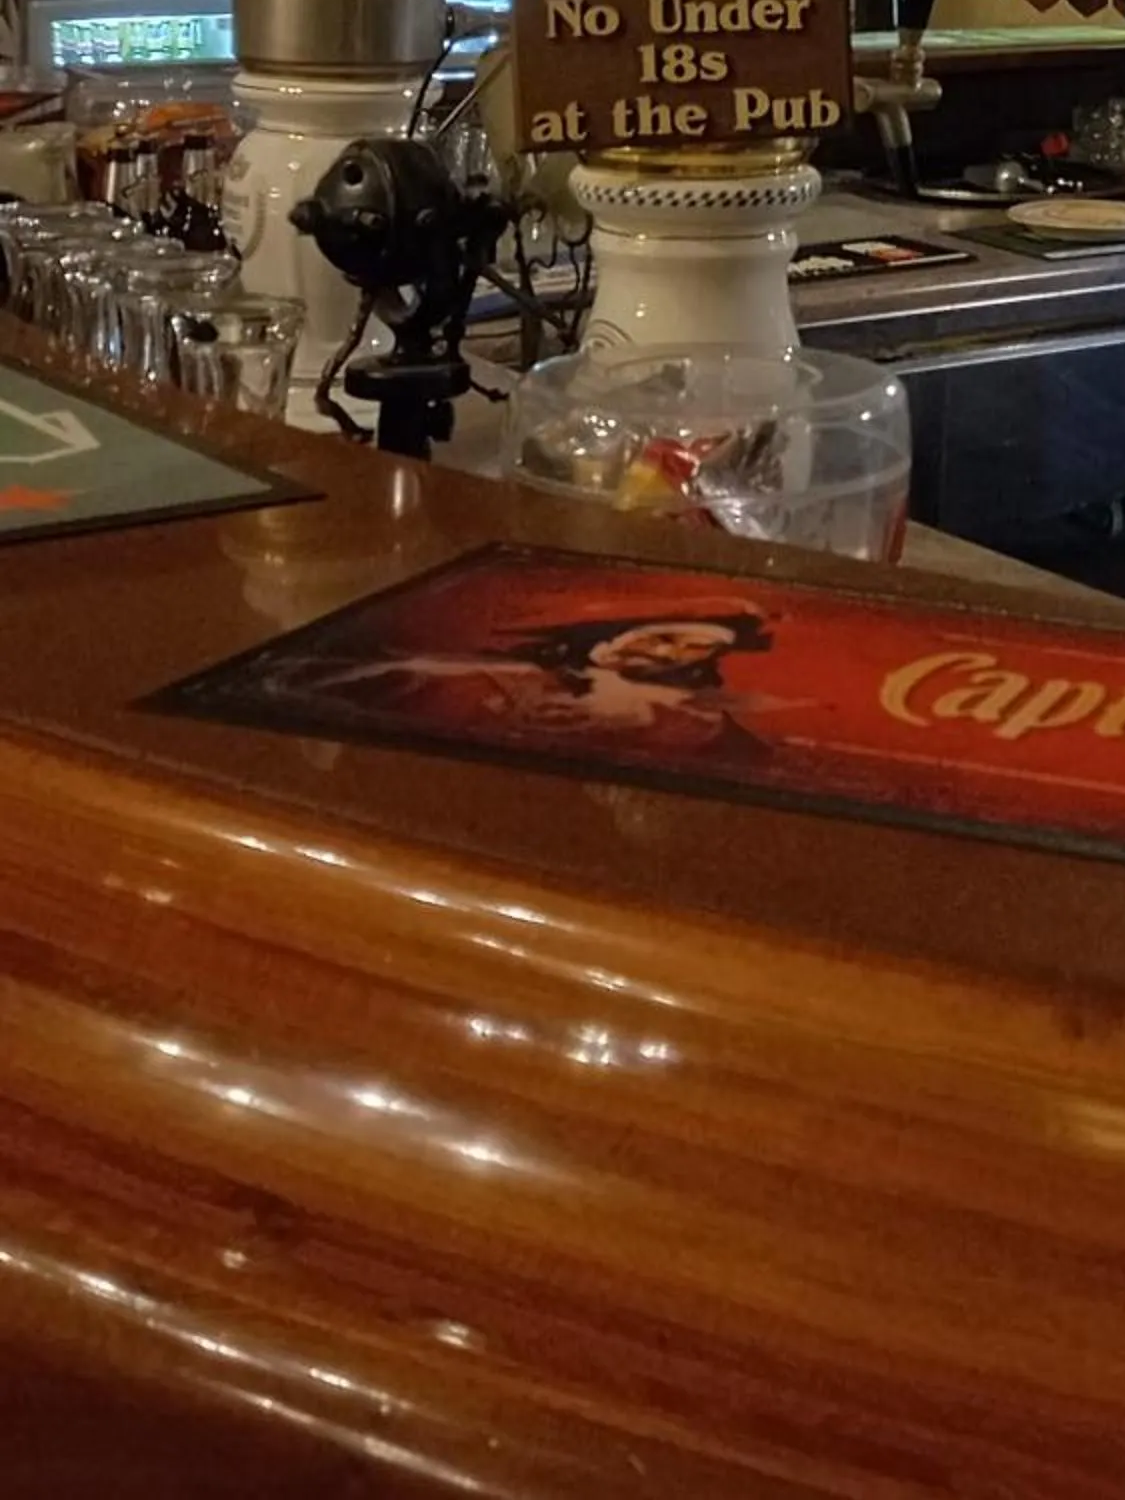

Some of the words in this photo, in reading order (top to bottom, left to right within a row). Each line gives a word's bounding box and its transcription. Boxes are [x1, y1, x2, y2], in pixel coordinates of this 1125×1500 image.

[638, 43, 729, 83] 18s
[530, 101, 587, 142] at
[612, 95, 708, 138] the
[733, 87, 841, 132] Pub
